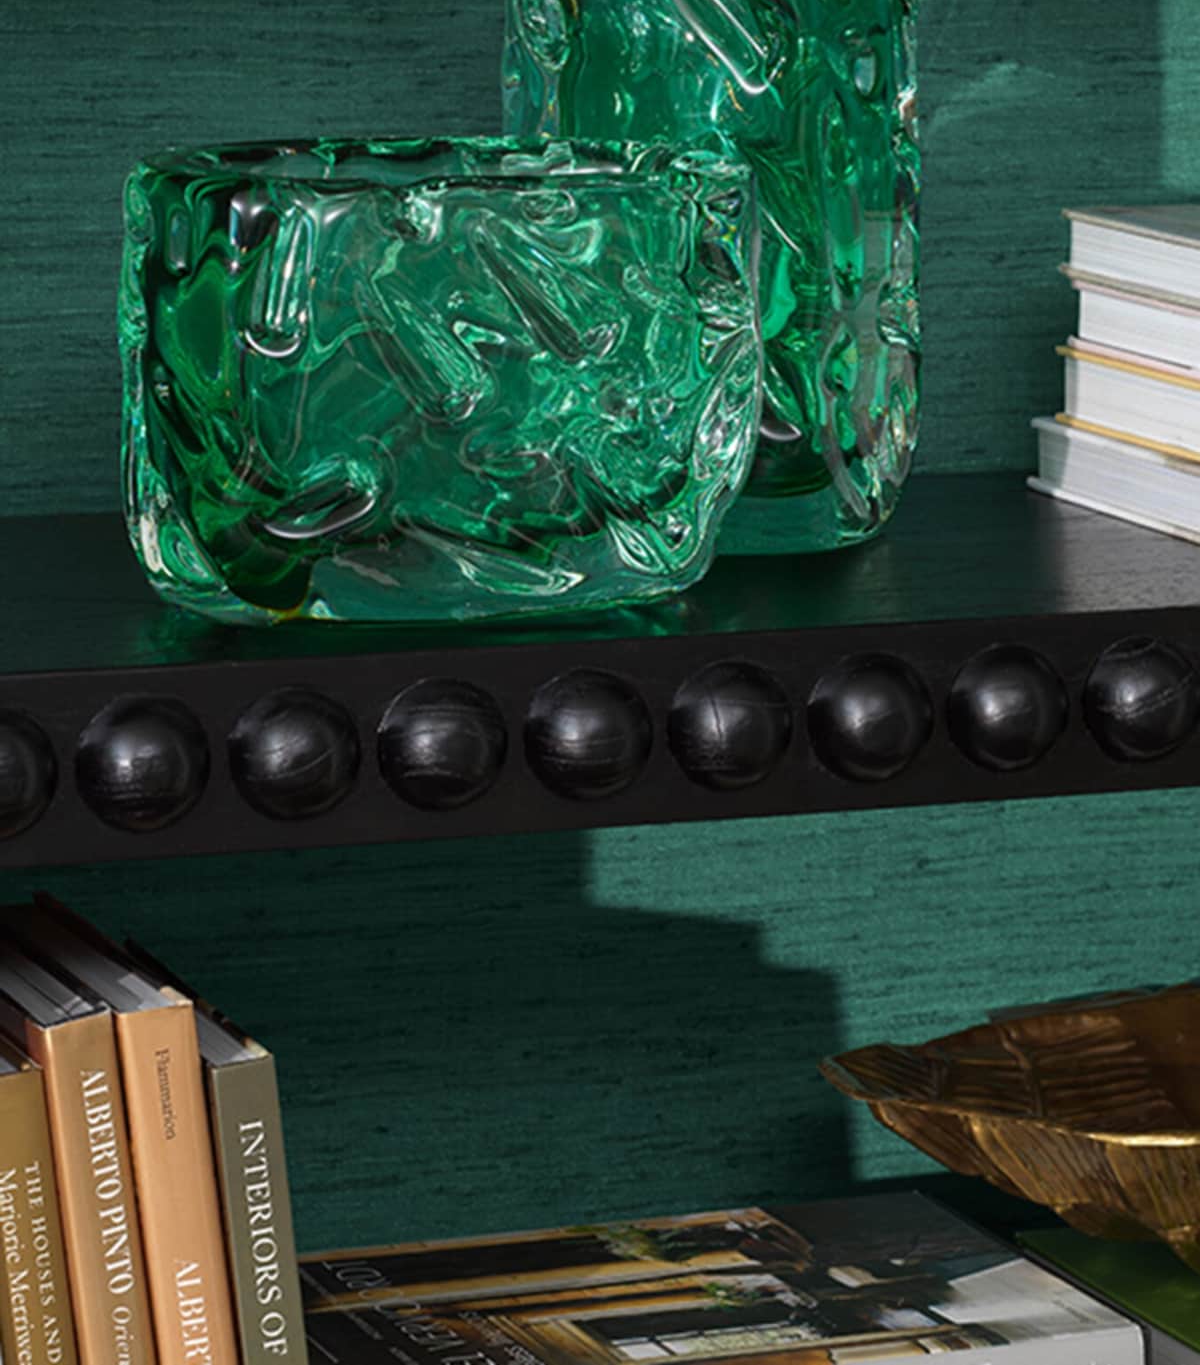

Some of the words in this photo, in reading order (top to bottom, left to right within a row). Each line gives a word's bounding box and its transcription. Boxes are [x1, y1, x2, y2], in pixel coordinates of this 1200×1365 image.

[80, 1070, 123, 1202] ALBERTO
[155, 1048, 177, 1141] Flammarion
[0, 1167, 27, 1264] Marjorie
[24, 1160, 44, 1210] THE
[238, 1120, 283, 1305] INTERIORS
[31, 1216, 56, 1307] HOUSES
[99, 1203, 136, 1295] PINTO
[8, 1268, 36, 1365] Merriwe
[42, 1315, 63, 1364] AND
[260, 1311, 289, 1357] OF
